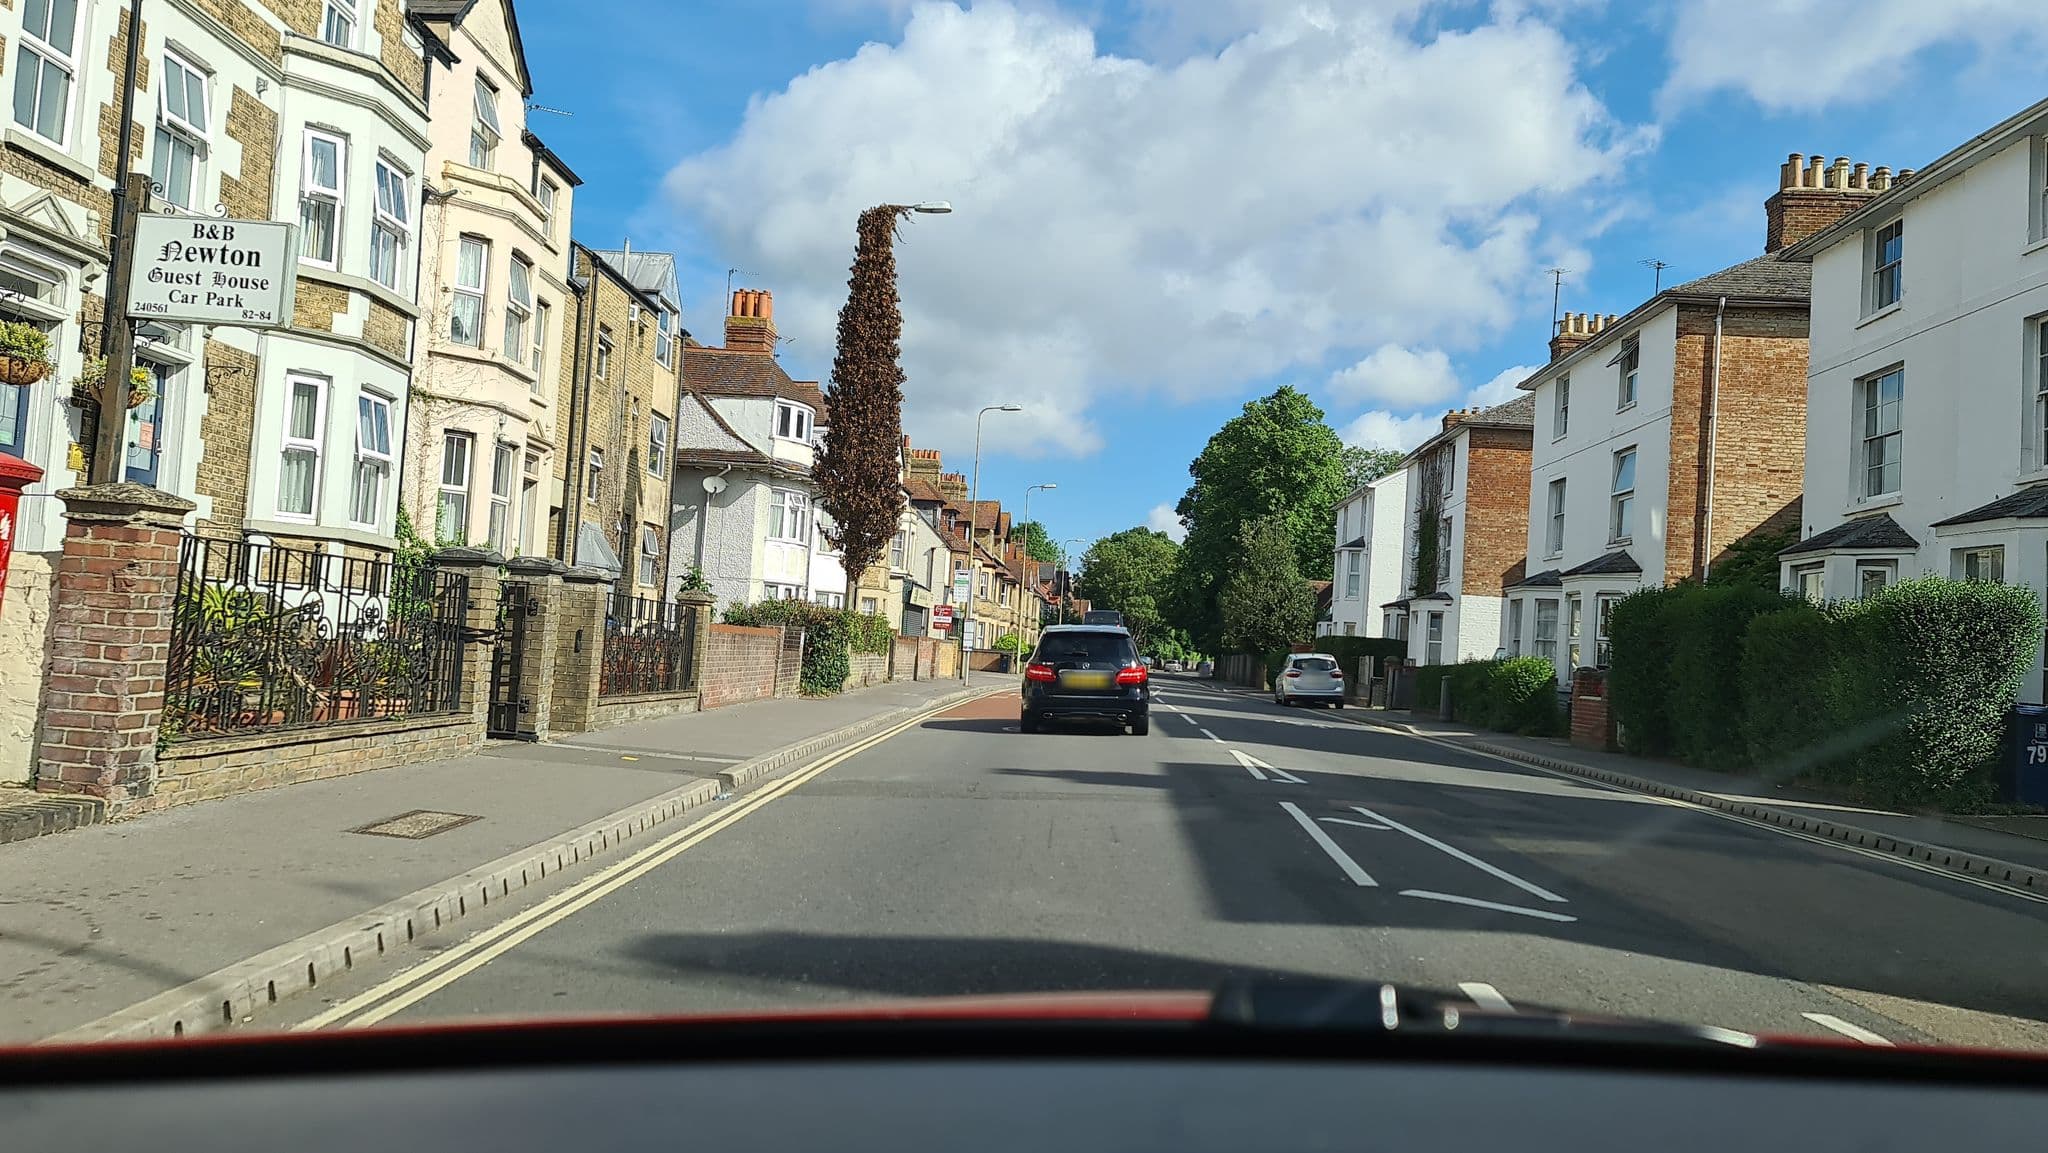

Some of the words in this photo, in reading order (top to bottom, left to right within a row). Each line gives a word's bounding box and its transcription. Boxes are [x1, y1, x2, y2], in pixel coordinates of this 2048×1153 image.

[192, 223, 234, 241] B&B
[156, 240, 261, 267] Newton
[148, 267, 202, 286] Guest
[212, 271, 269, 290] House
[134, 302, 168, 313] 240561
[168, 289, 198, 305] Car
[205, 291, 244, 308] Park
[242, 309, 271, 321] 82-84
[2027, 745, 2047, 764] 79
